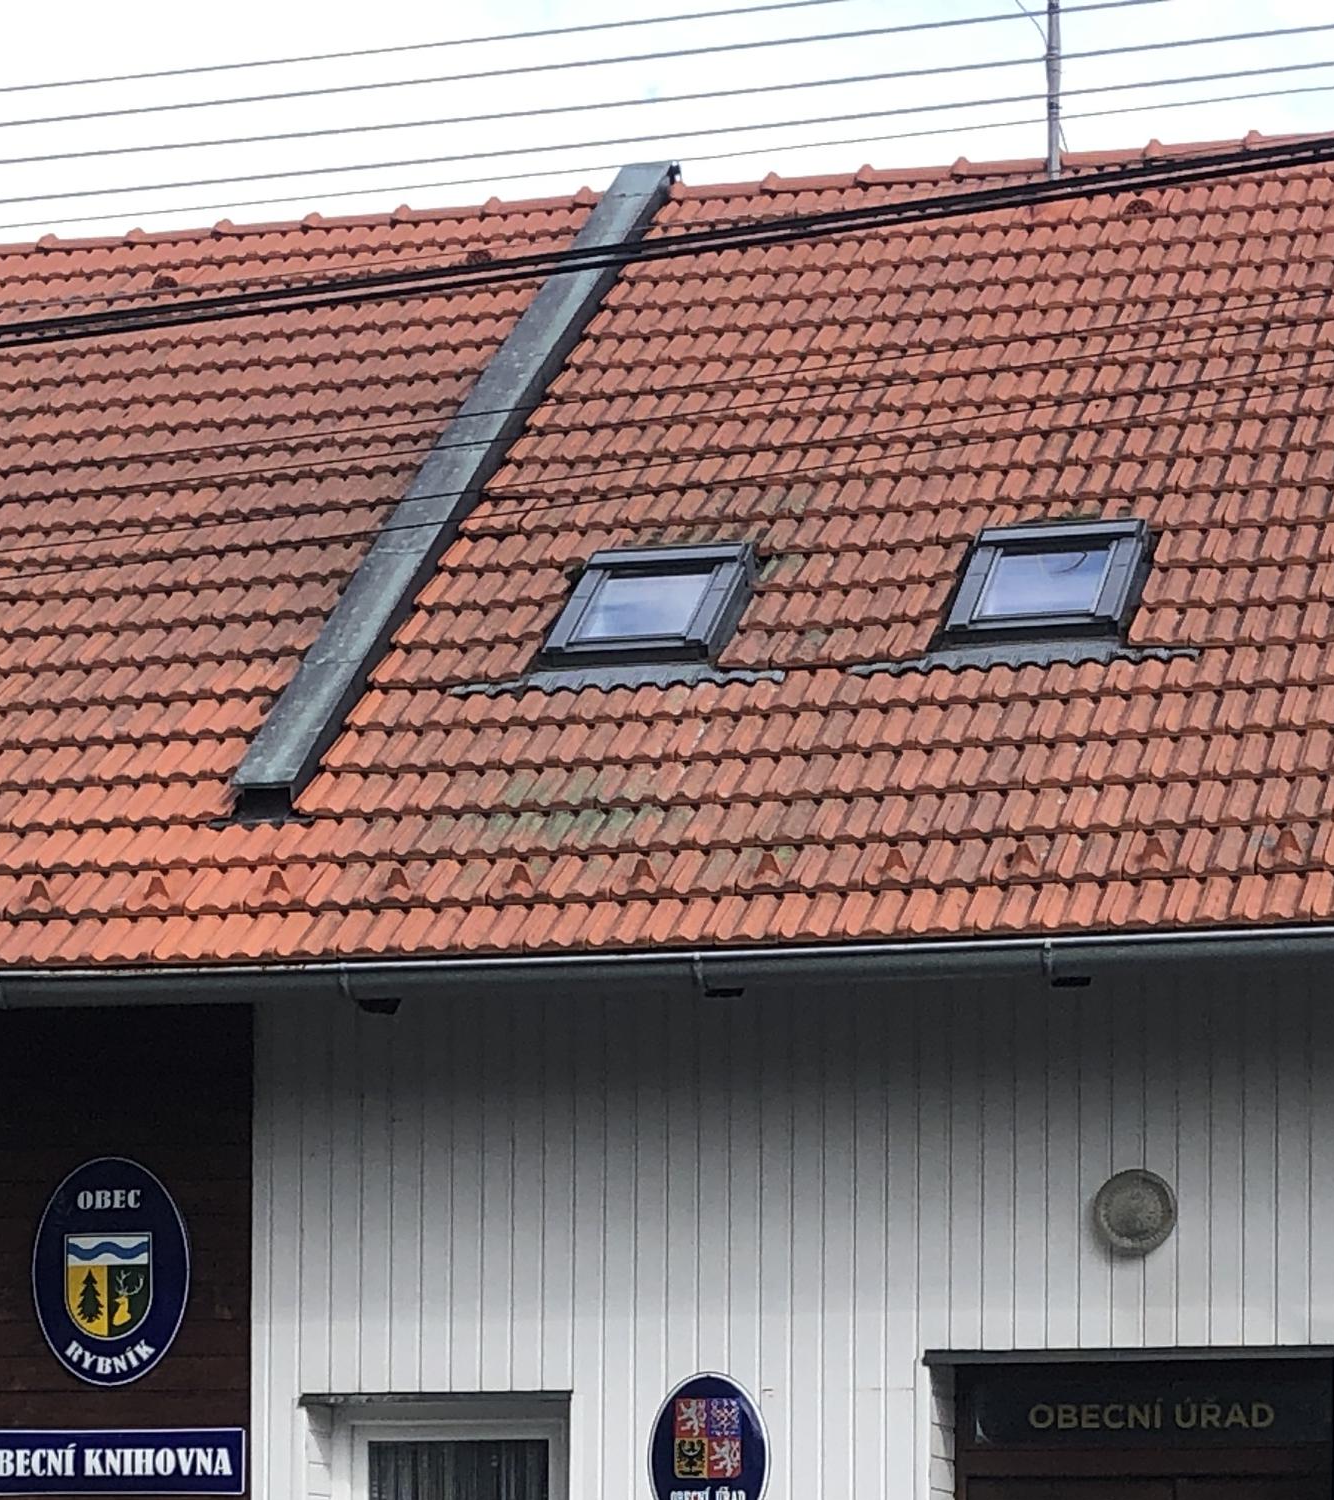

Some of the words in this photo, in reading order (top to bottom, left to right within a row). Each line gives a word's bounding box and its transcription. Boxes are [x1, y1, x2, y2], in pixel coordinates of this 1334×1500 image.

[77, 1189, 141, 1210] OBEC
[64, 1338, 156, 1374] RYBNÍK
[1029, 1397, 1163, 1429] OBECNÍ
[1174, 1396, 1275, 1429] ÚŘAD
[83, 1447, 232, 1477] KNIHOVNA
